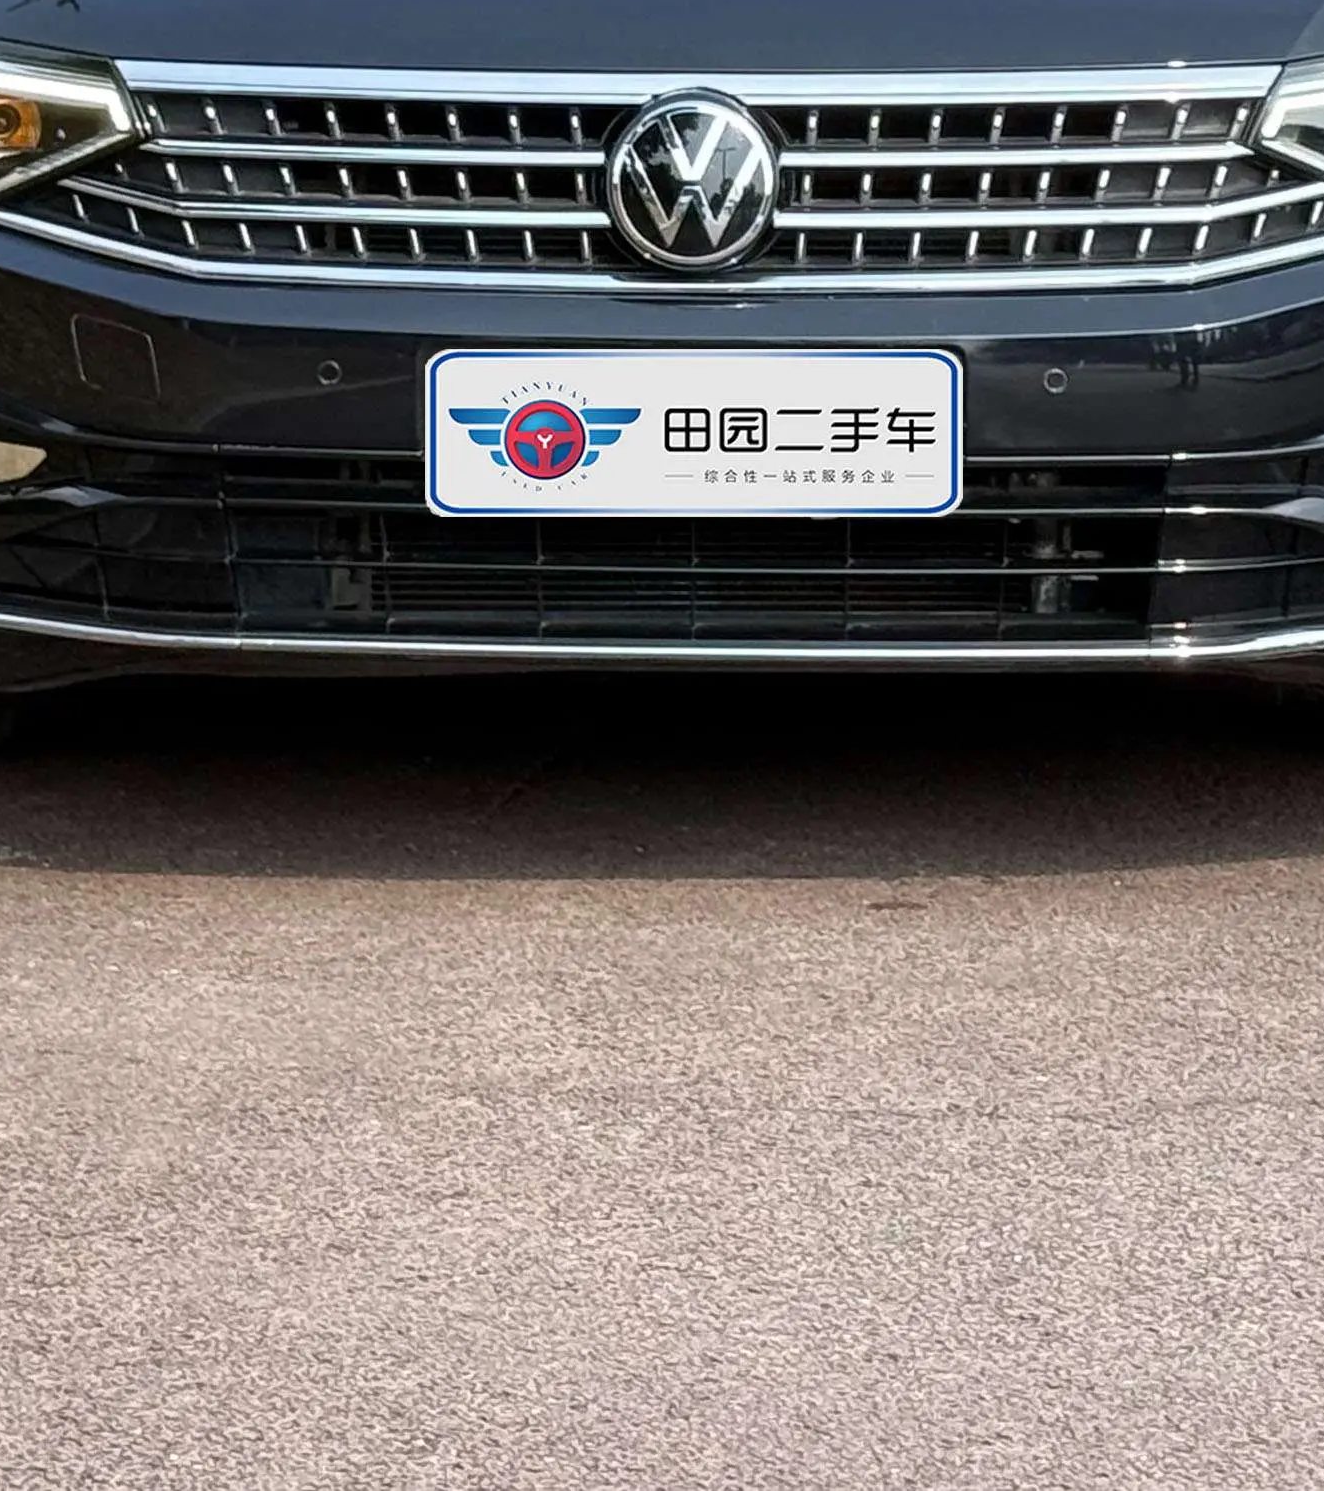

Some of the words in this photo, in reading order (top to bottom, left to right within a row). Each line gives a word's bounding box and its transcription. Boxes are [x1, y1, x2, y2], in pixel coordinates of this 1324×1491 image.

[624, 111, 765, 249] VW
[664, 407, 936, 453] 田园二手车
[704, 469, 895, 484] 综合性一站式服务企业
